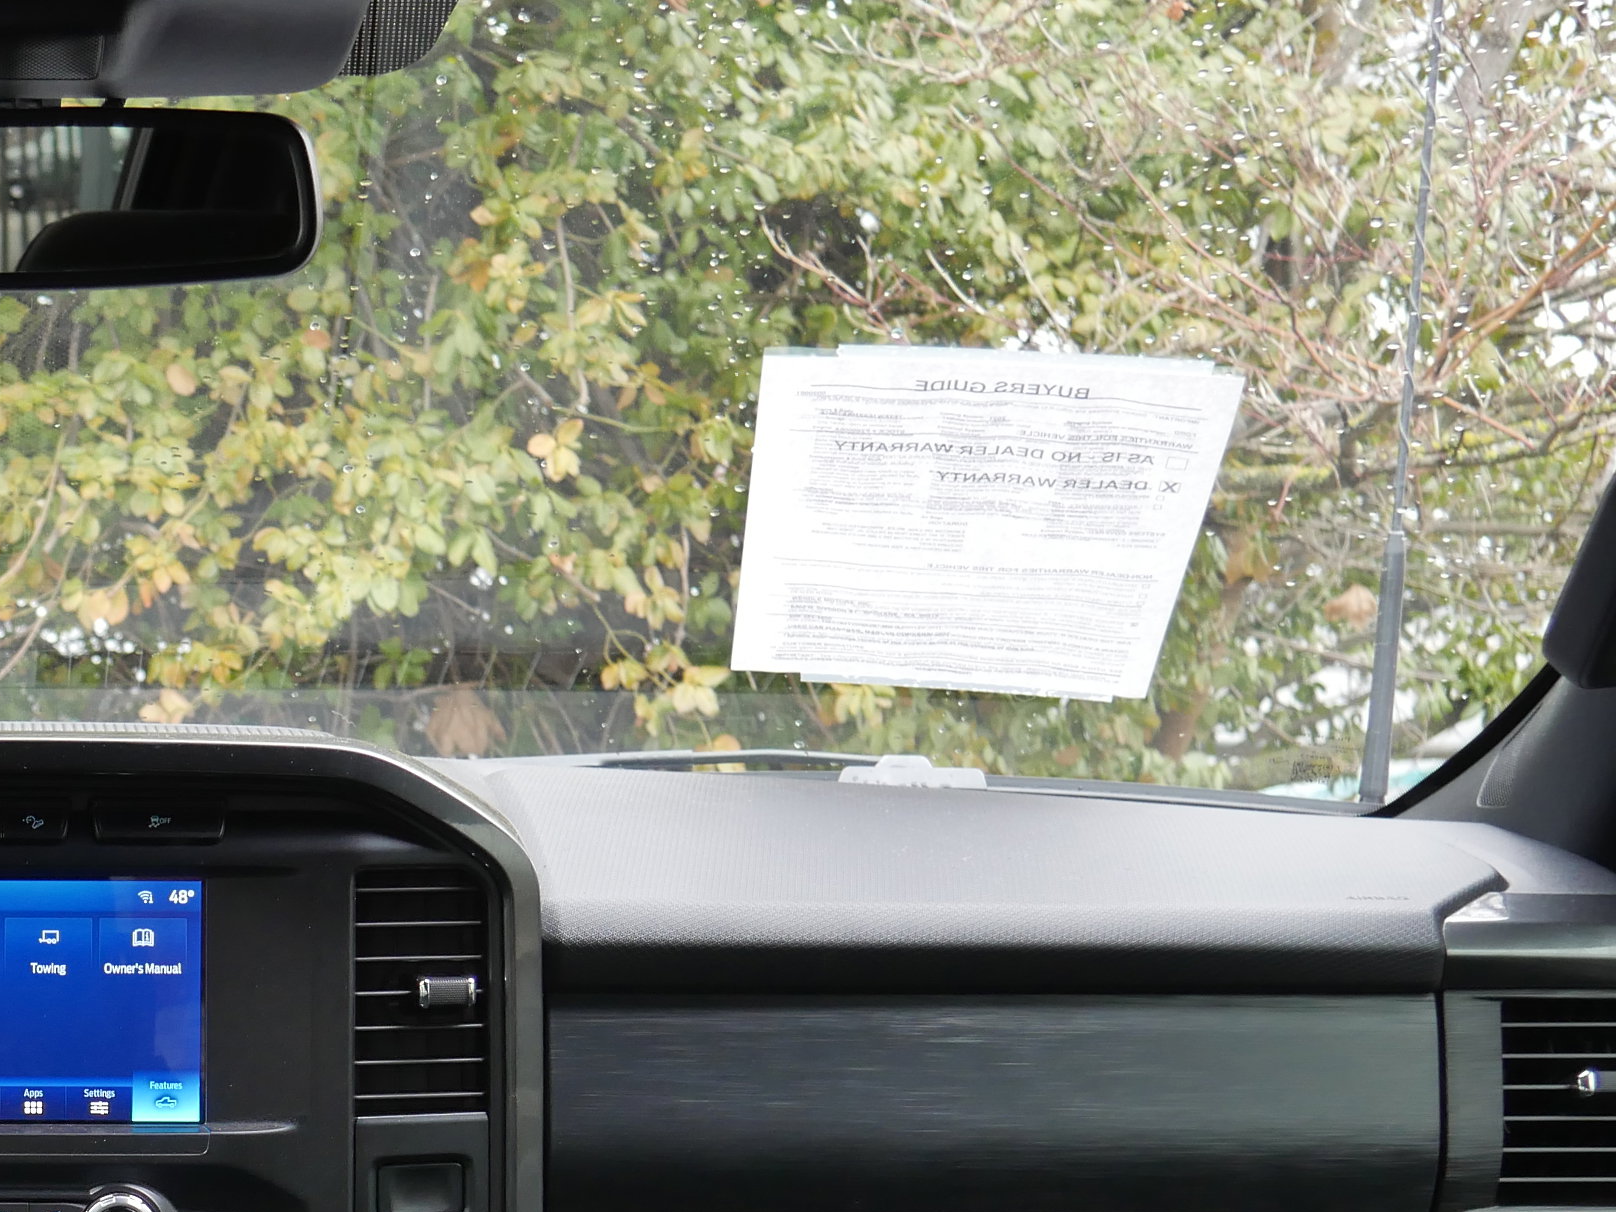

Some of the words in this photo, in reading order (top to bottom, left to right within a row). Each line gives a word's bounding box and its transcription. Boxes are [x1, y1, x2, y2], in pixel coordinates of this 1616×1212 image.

[168, 889, 195, 904] 48°
[30, 962, 66, 976] Towing
[103, 962, 144, 974] Owner's
[145, 962, 182, 974] Manual
[149, 1080, 183, 1090] Features
[23, 1088, 44, 1100] Apps
[83, 1088, 116, 1100] Settings
